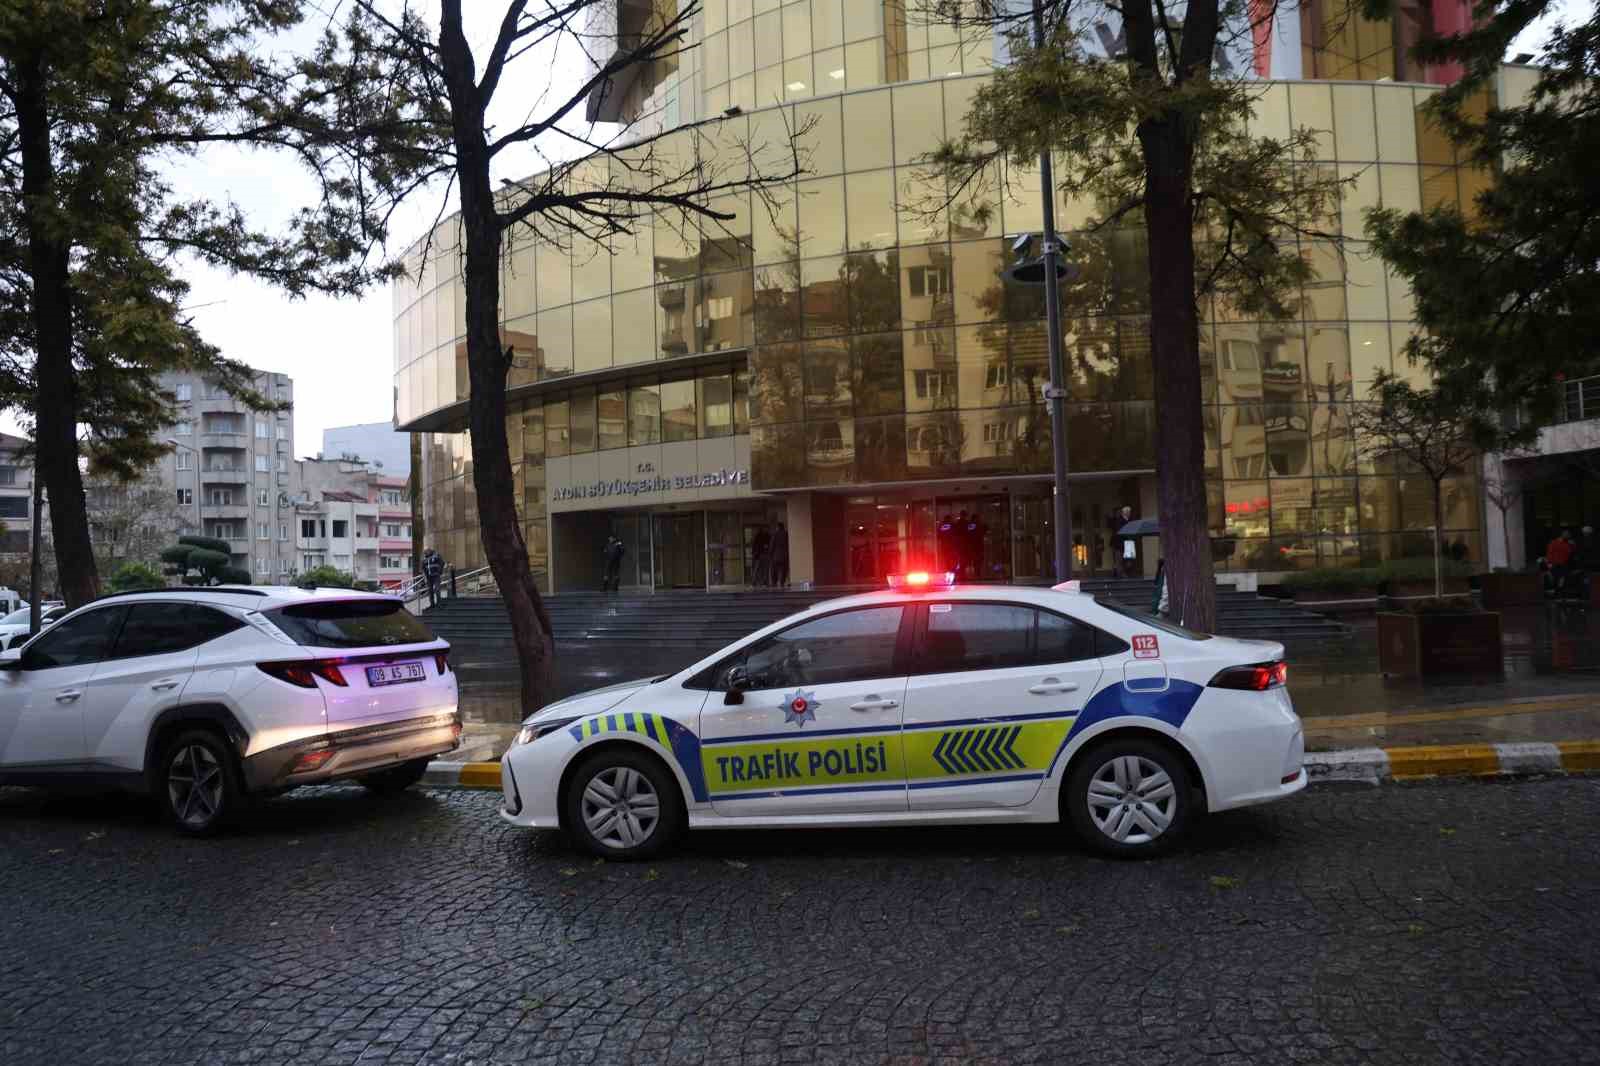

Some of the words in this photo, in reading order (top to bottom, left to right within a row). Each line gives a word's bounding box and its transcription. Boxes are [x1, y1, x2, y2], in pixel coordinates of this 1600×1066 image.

[553, 486, 587, 501] AYDIN
[1136, 637, 1156, 649] 112
[716, 749, 801, 783] TRAFİK
[808, 741, 887, 776] POLİSİ
